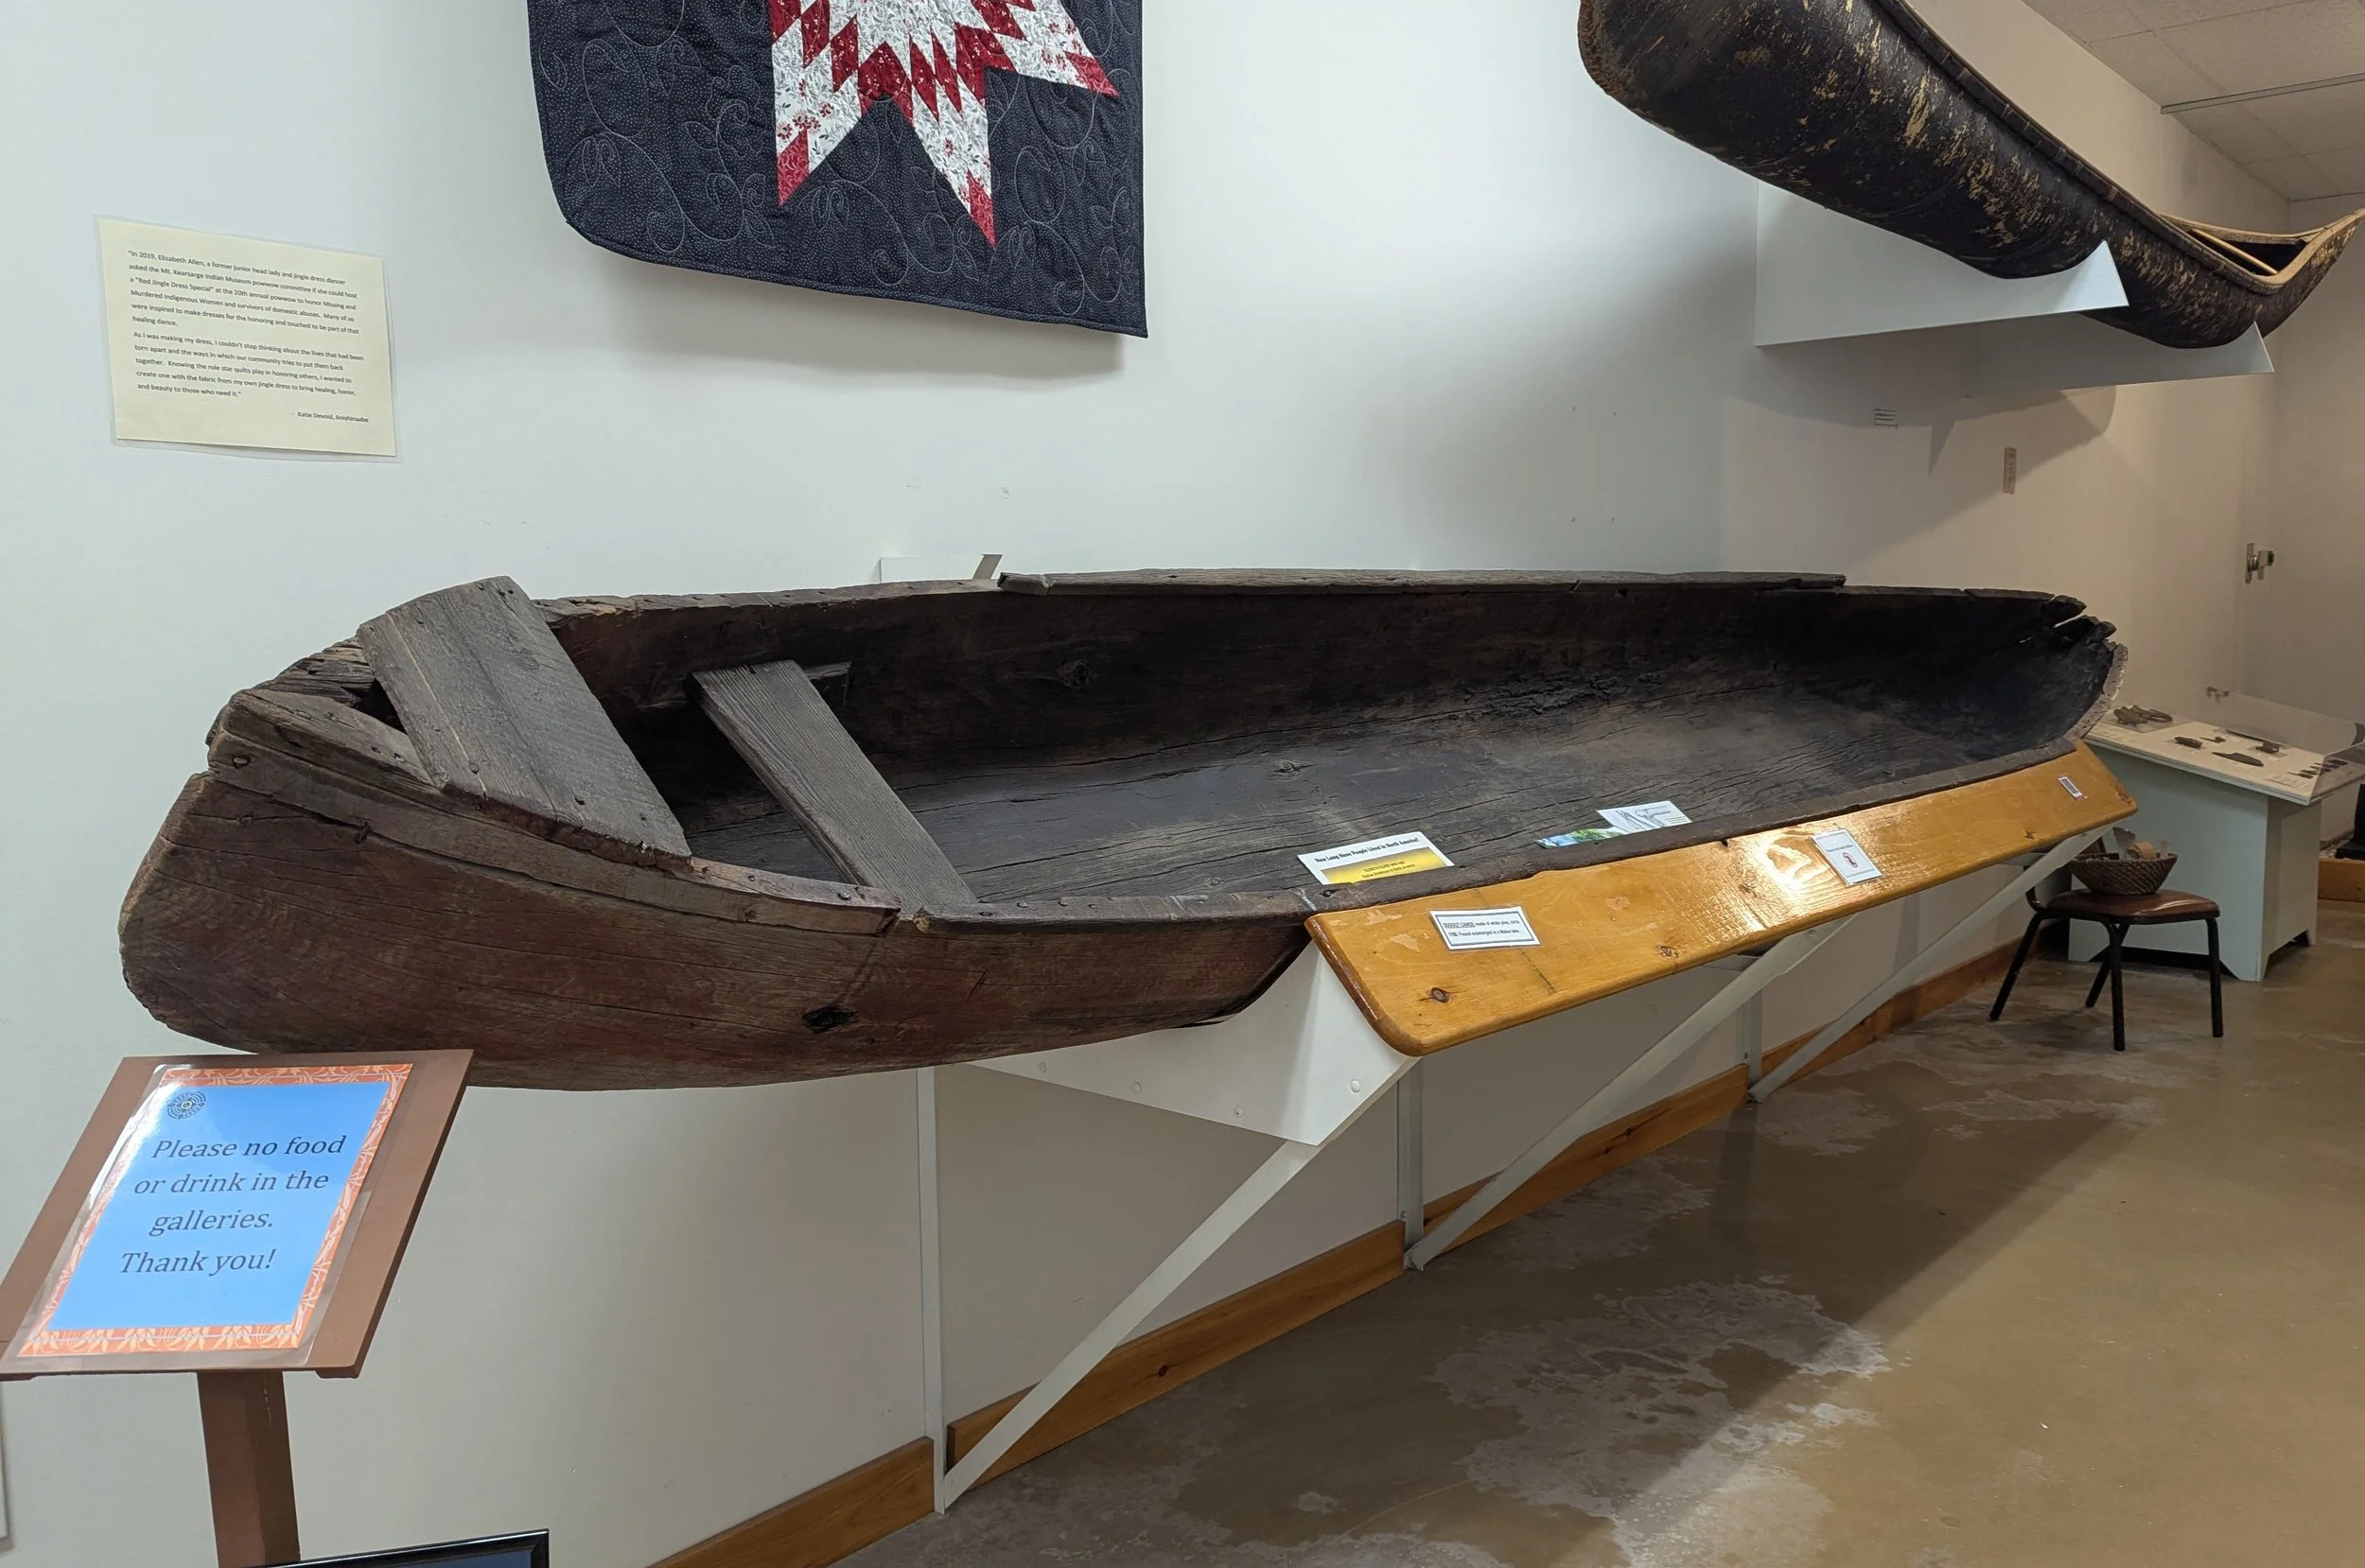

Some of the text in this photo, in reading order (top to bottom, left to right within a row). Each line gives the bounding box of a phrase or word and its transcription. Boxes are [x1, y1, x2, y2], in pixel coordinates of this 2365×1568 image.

[158, 254, 186, 263] Elizabeth
[174, 270, 203, 279] Kearsarge
[225, 276, 251, 285] Museum
[280, 284, 310, 292] committee
[131, 290, 163, 299] Murdered
[165, 294, 198, 303] Indigenous
[237, 303, 263, 311] survivors
[132, 316, 155, 324] healing
[149, 305, 174, 313] inspired
[248, 316, 273, 325] honoring
[248, 357, 281, 365] community
[151, 1136, 346, 1158] Please no food
[134, 1171, 329, 1194] or drink in the
[149, 1210, 273, 1237] galleries.
[120, 1249, 276, 1277] Thank you!
